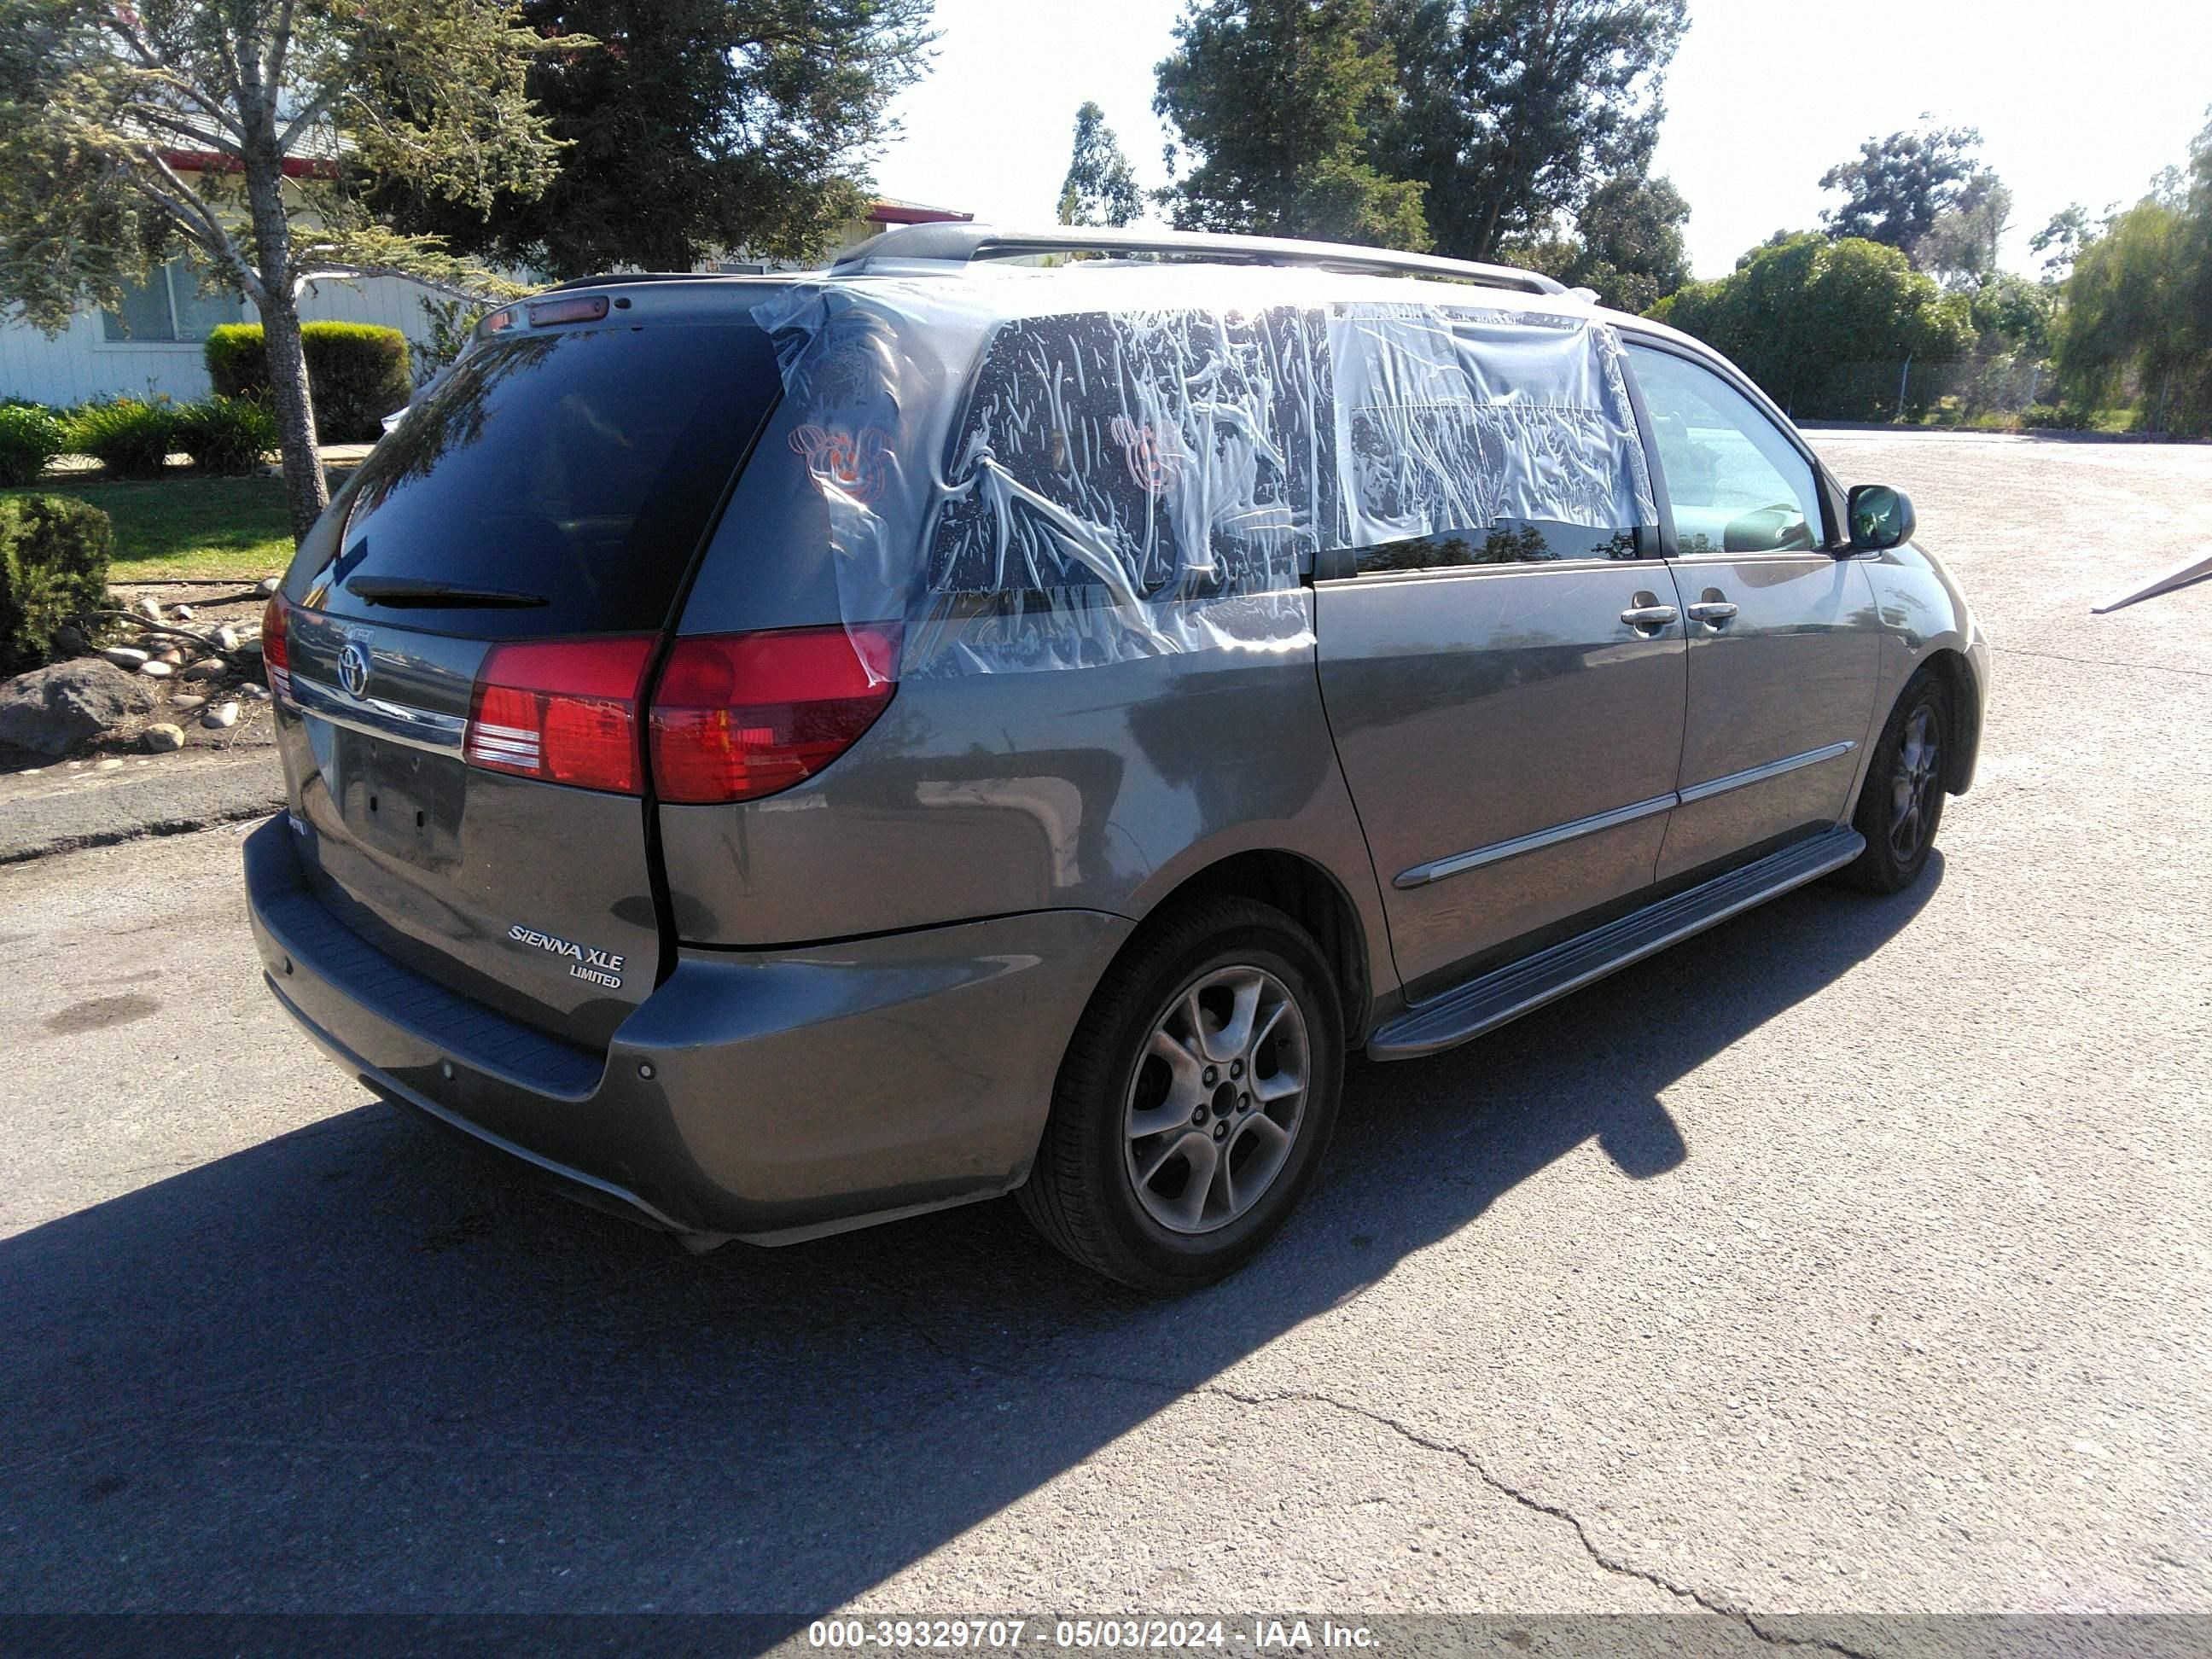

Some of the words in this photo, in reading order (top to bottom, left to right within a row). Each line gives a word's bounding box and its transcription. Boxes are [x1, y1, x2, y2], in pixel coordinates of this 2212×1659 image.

[508, 925, 583, 960] SIENNA
[585, 948, 625, 971] XLE
[569, 964, 621, 989] LIMITED
